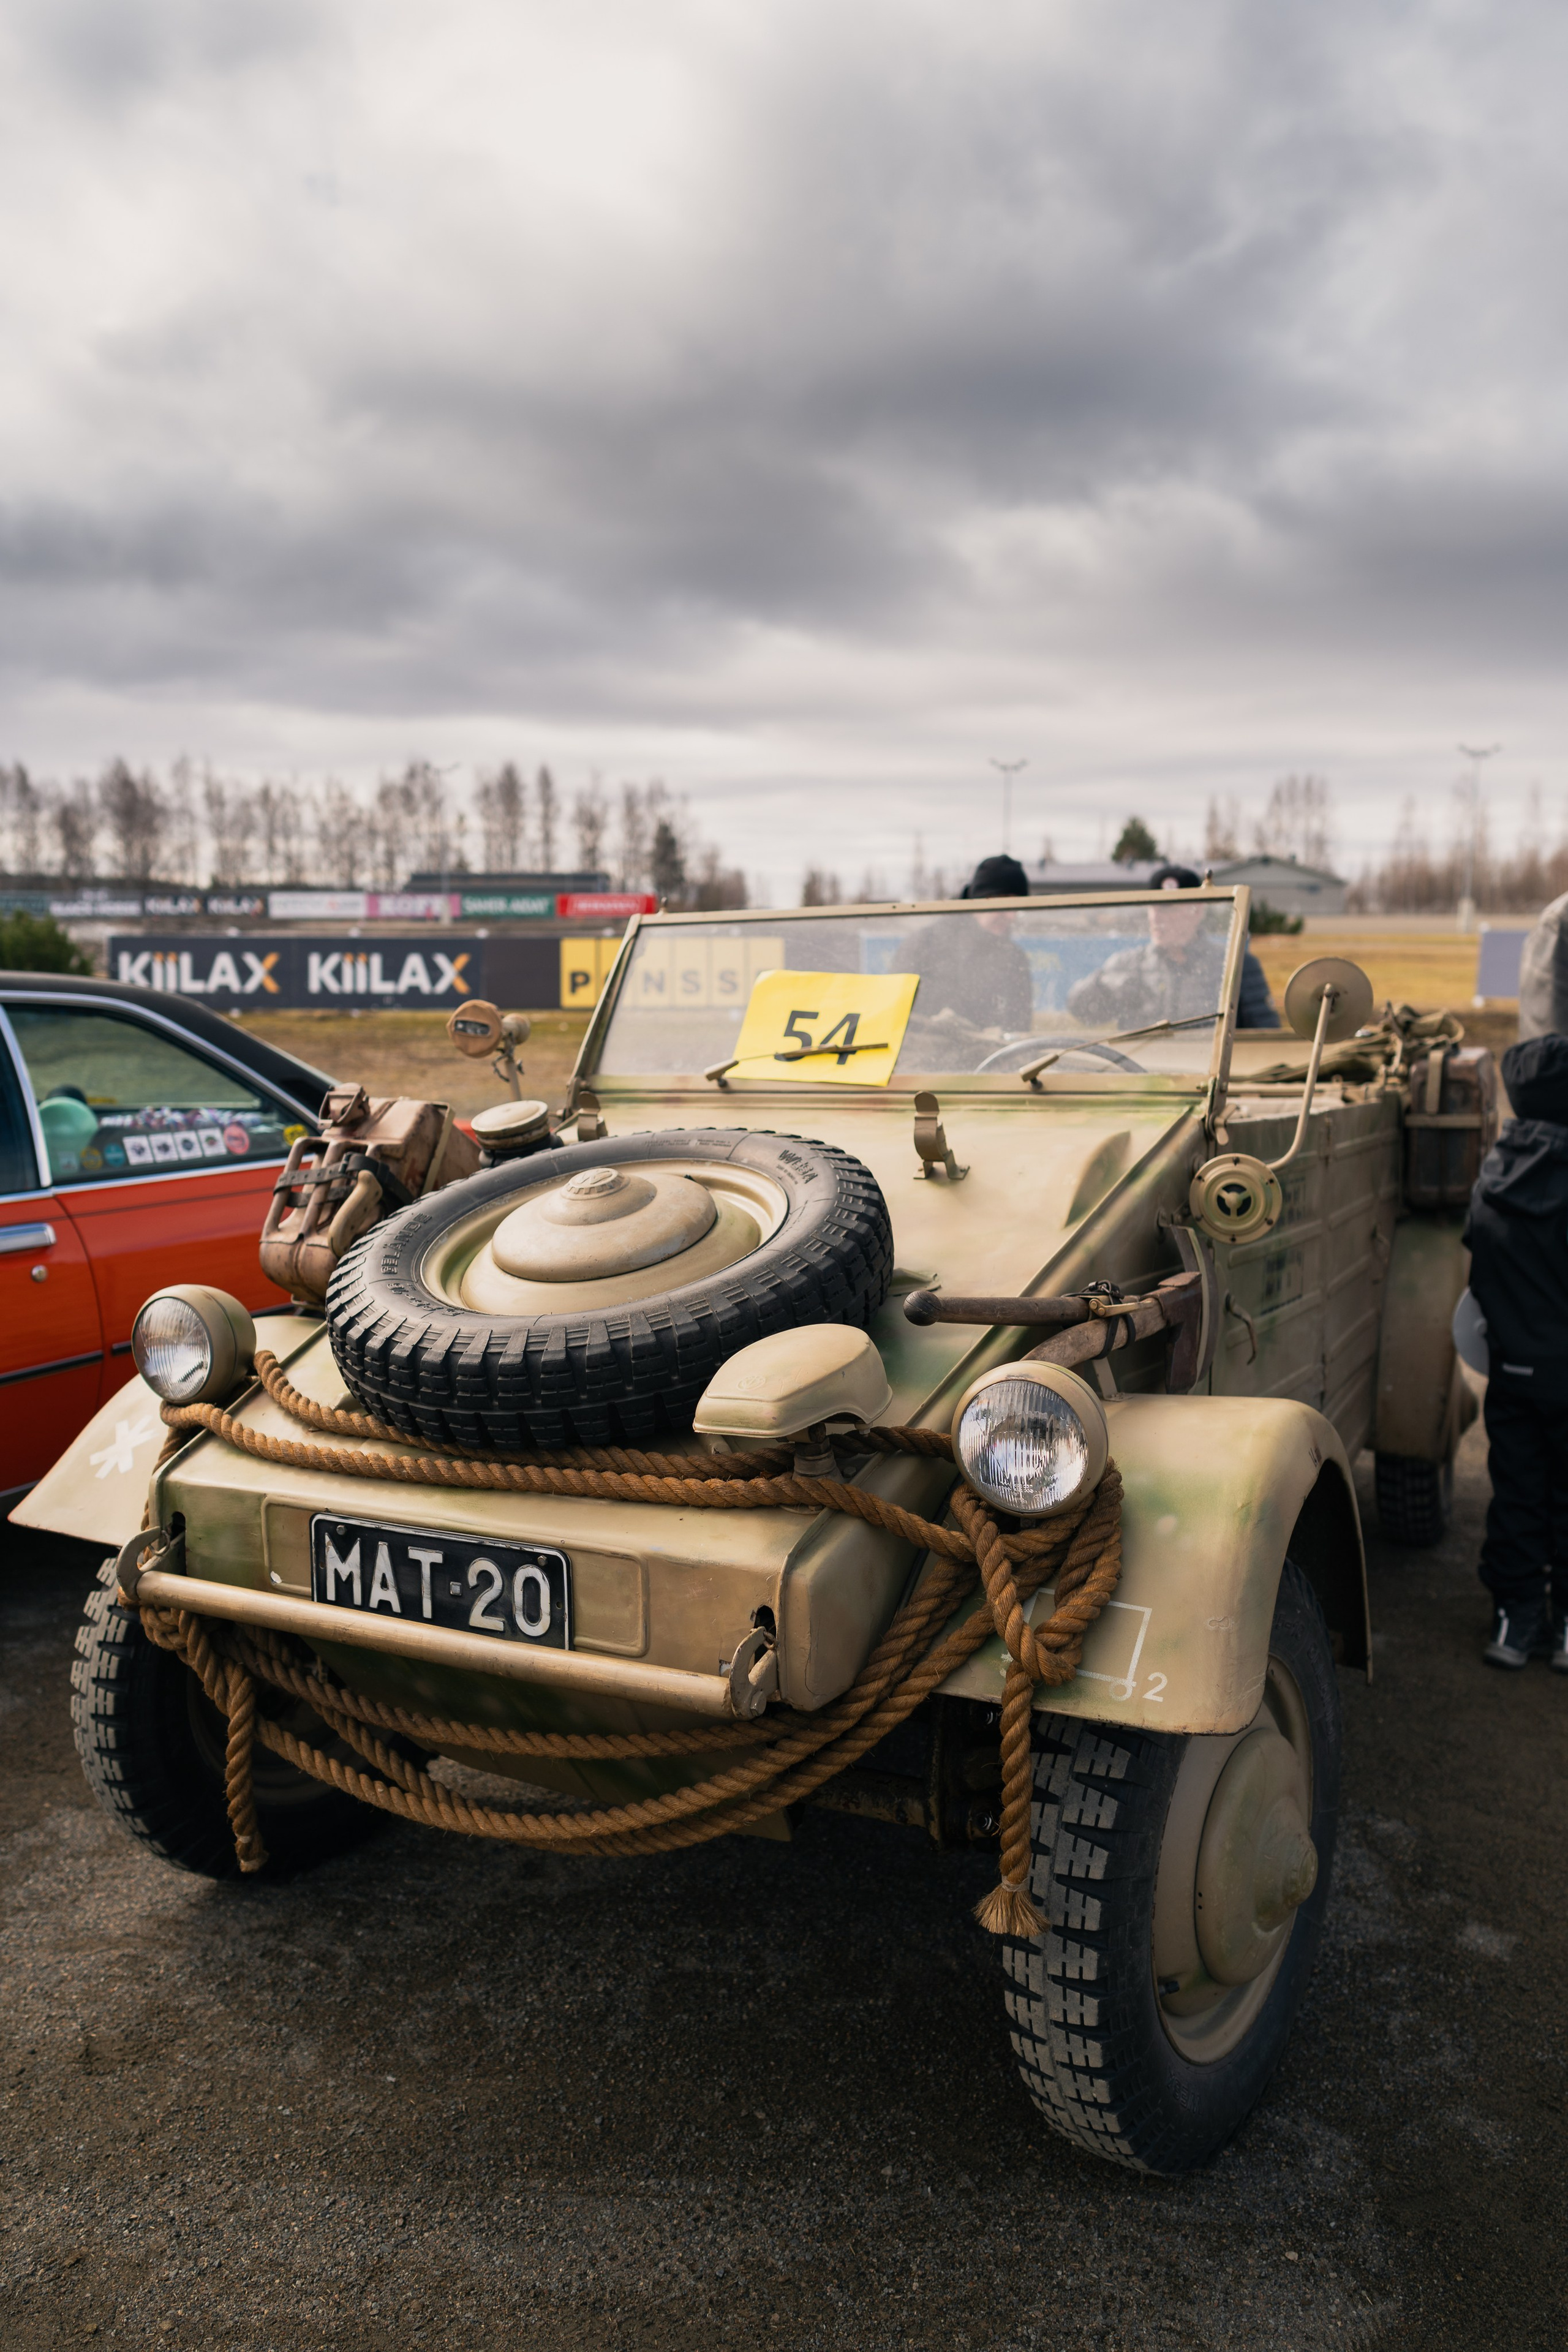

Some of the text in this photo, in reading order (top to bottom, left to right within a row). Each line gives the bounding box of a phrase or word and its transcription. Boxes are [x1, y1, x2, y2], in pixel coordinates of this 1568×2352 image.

[569, 970, 769, 995] PNSS
[774, 1010, 861, 1065] 54
[1142, 1672, 1168, 1702] 2
